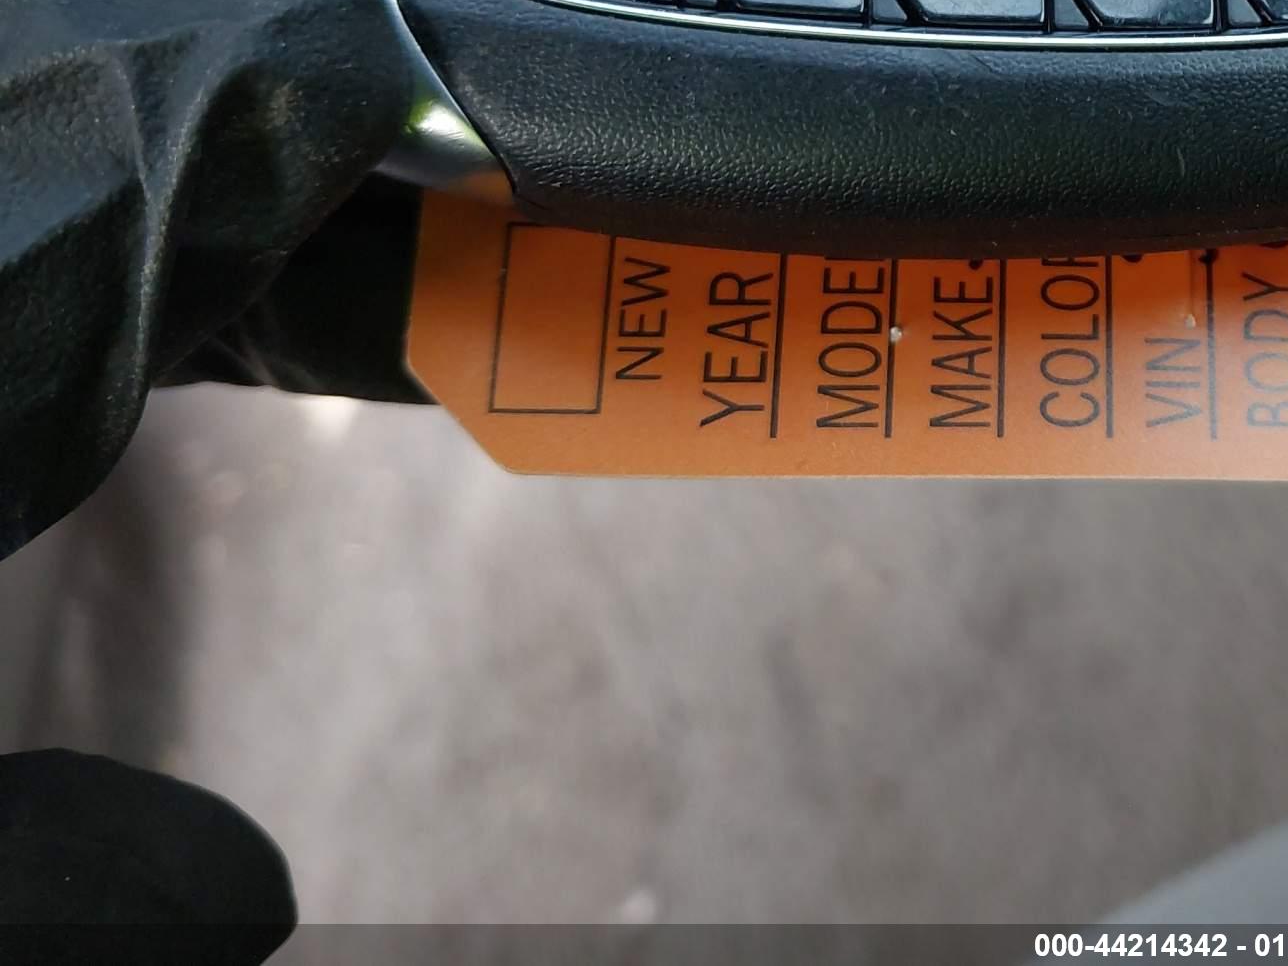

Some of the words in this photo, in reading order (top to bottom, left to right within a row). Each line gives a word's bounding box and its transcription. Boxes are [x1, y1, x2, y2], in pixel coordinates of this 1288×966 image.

[614, 256, 672, 380] NEW
[700, 270, 774, 427] YEAR
[815, 256, 885, 428] MODE
[929, 275, 994, 427] MAKE
[1144, 336, 1202, 428] VIN
